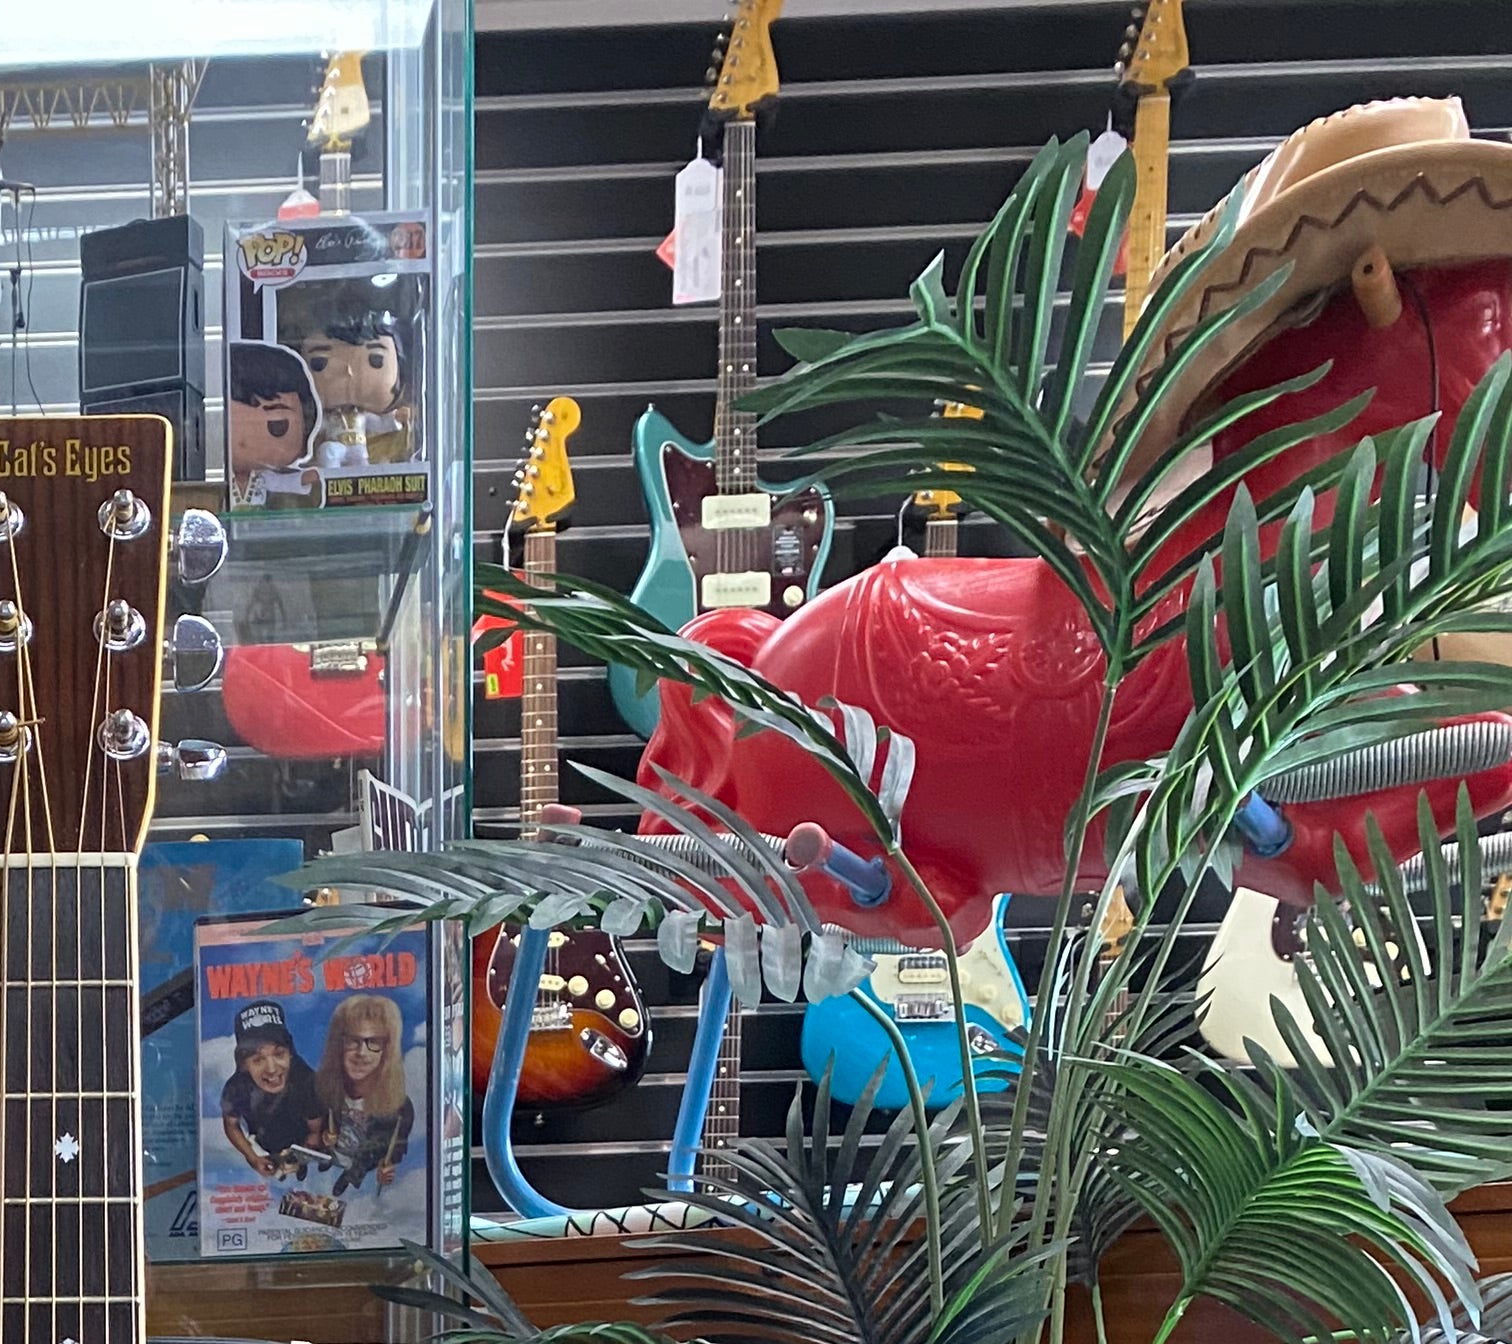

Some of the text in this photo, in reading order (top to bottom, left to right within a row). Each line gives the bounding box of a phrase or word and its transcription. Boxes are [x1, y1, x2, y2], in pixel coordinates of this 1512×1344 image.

[238, 231, 304, 270] POP!
[65, 439, 131, 482] Eyes
[328, 475, 426, 496] ELVIS PHARAOH SUIT
[206, 950, 417, 1000] WAYNE'S WORLD
[223, 1236, 243, 1247] PG
